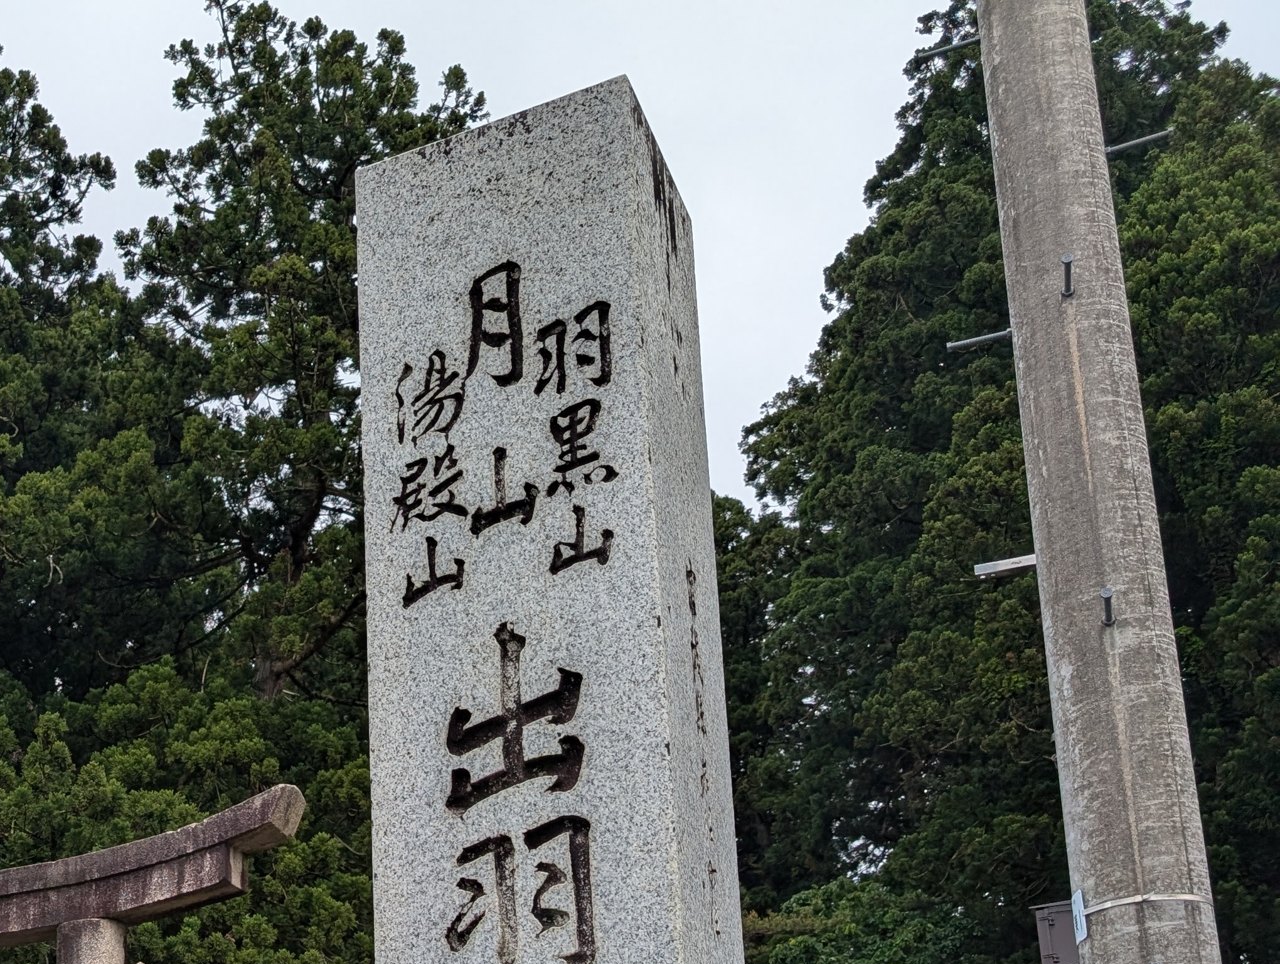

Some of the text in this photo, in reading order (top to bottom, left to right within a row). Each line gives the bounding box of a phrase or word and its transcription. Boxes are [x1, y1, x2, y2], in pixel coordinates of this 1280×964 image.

[390, 348, 470, 610] 湯殿山
[466, 259, 539, 537] 月山
[533, 300, 620, 576] 羽黒山
